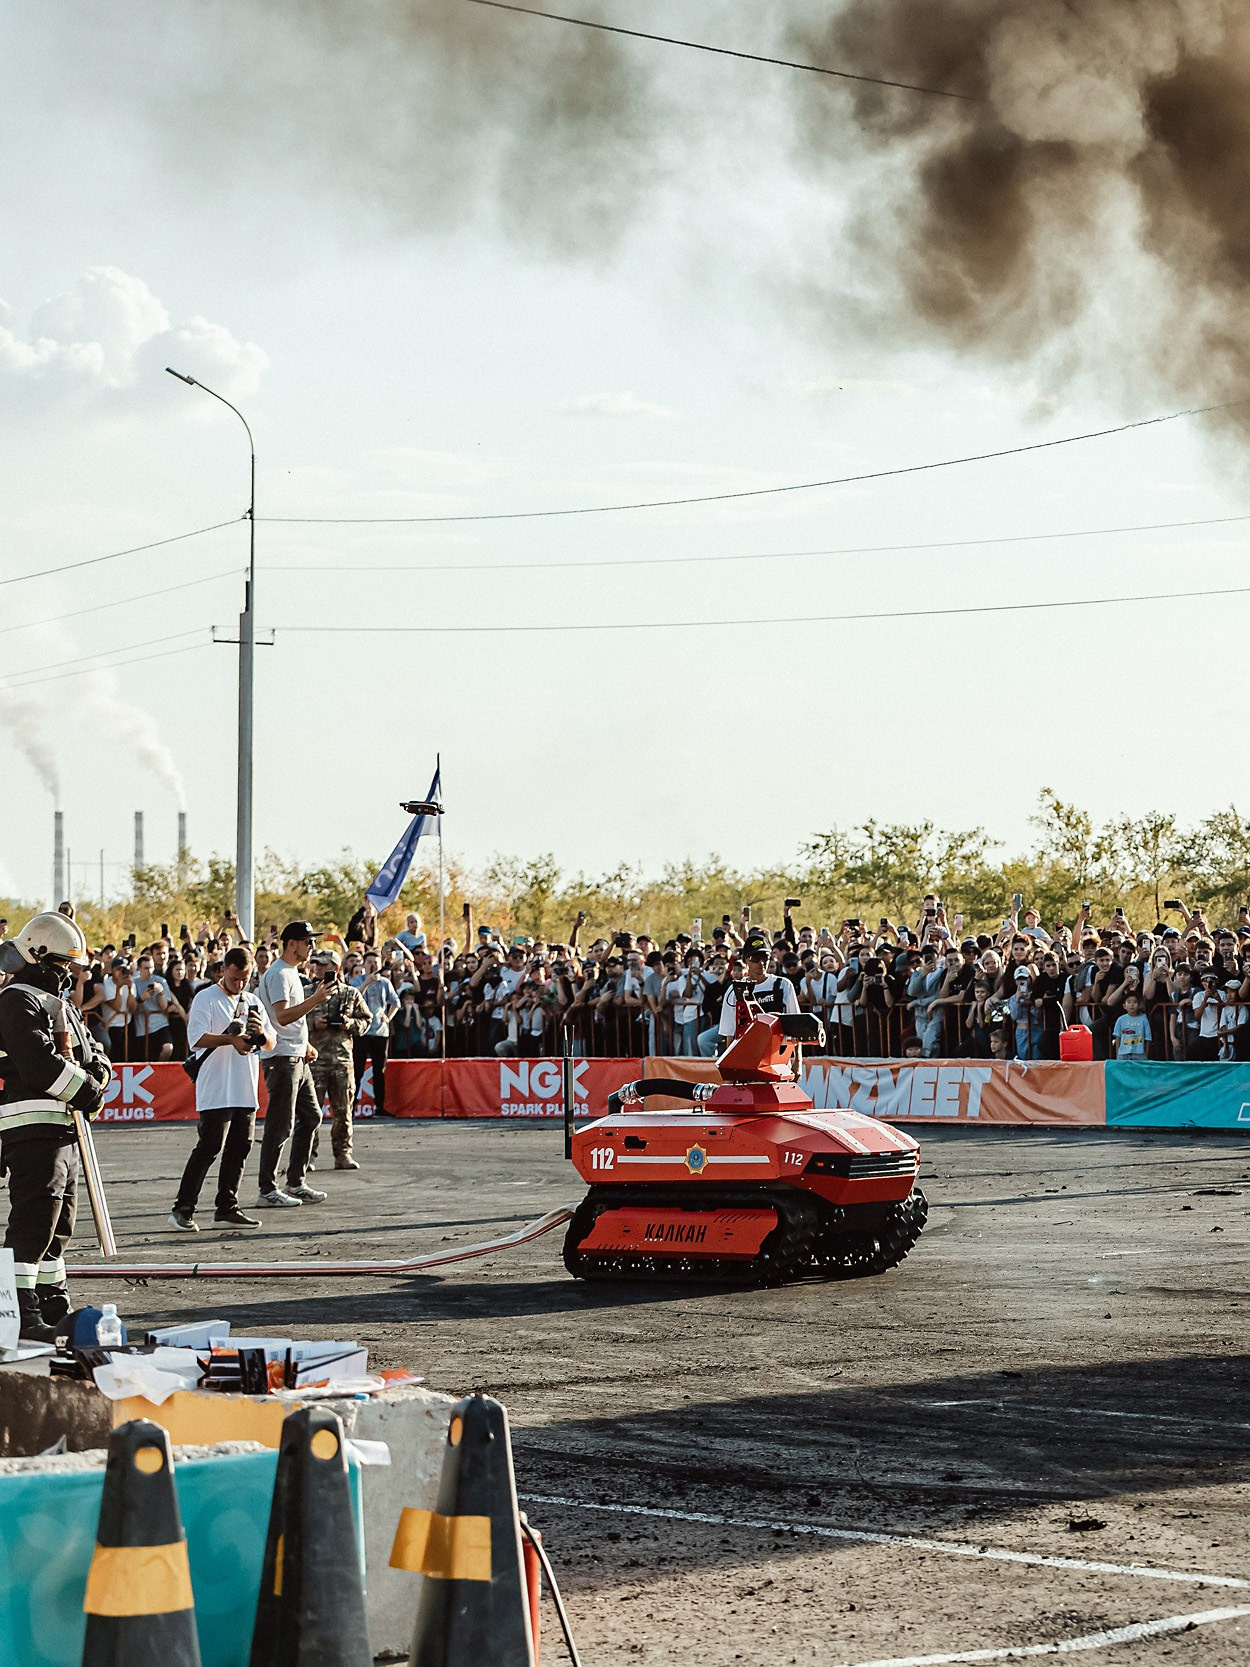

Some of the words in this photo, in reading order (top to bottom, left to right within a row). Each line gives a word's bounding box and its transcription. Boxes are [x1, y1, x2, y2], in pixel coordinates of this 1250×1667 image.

[500, 1060, 590, 1100] NGK
[104, 1107, 155, 1120] PLUGS
[501, 1103, 544, 1116] SPARK
[590, 1147, 615, 1170] 112
[783, 1151, 804, 1166] 112
[644, 1223, 708, 1243] КАЛКАН
